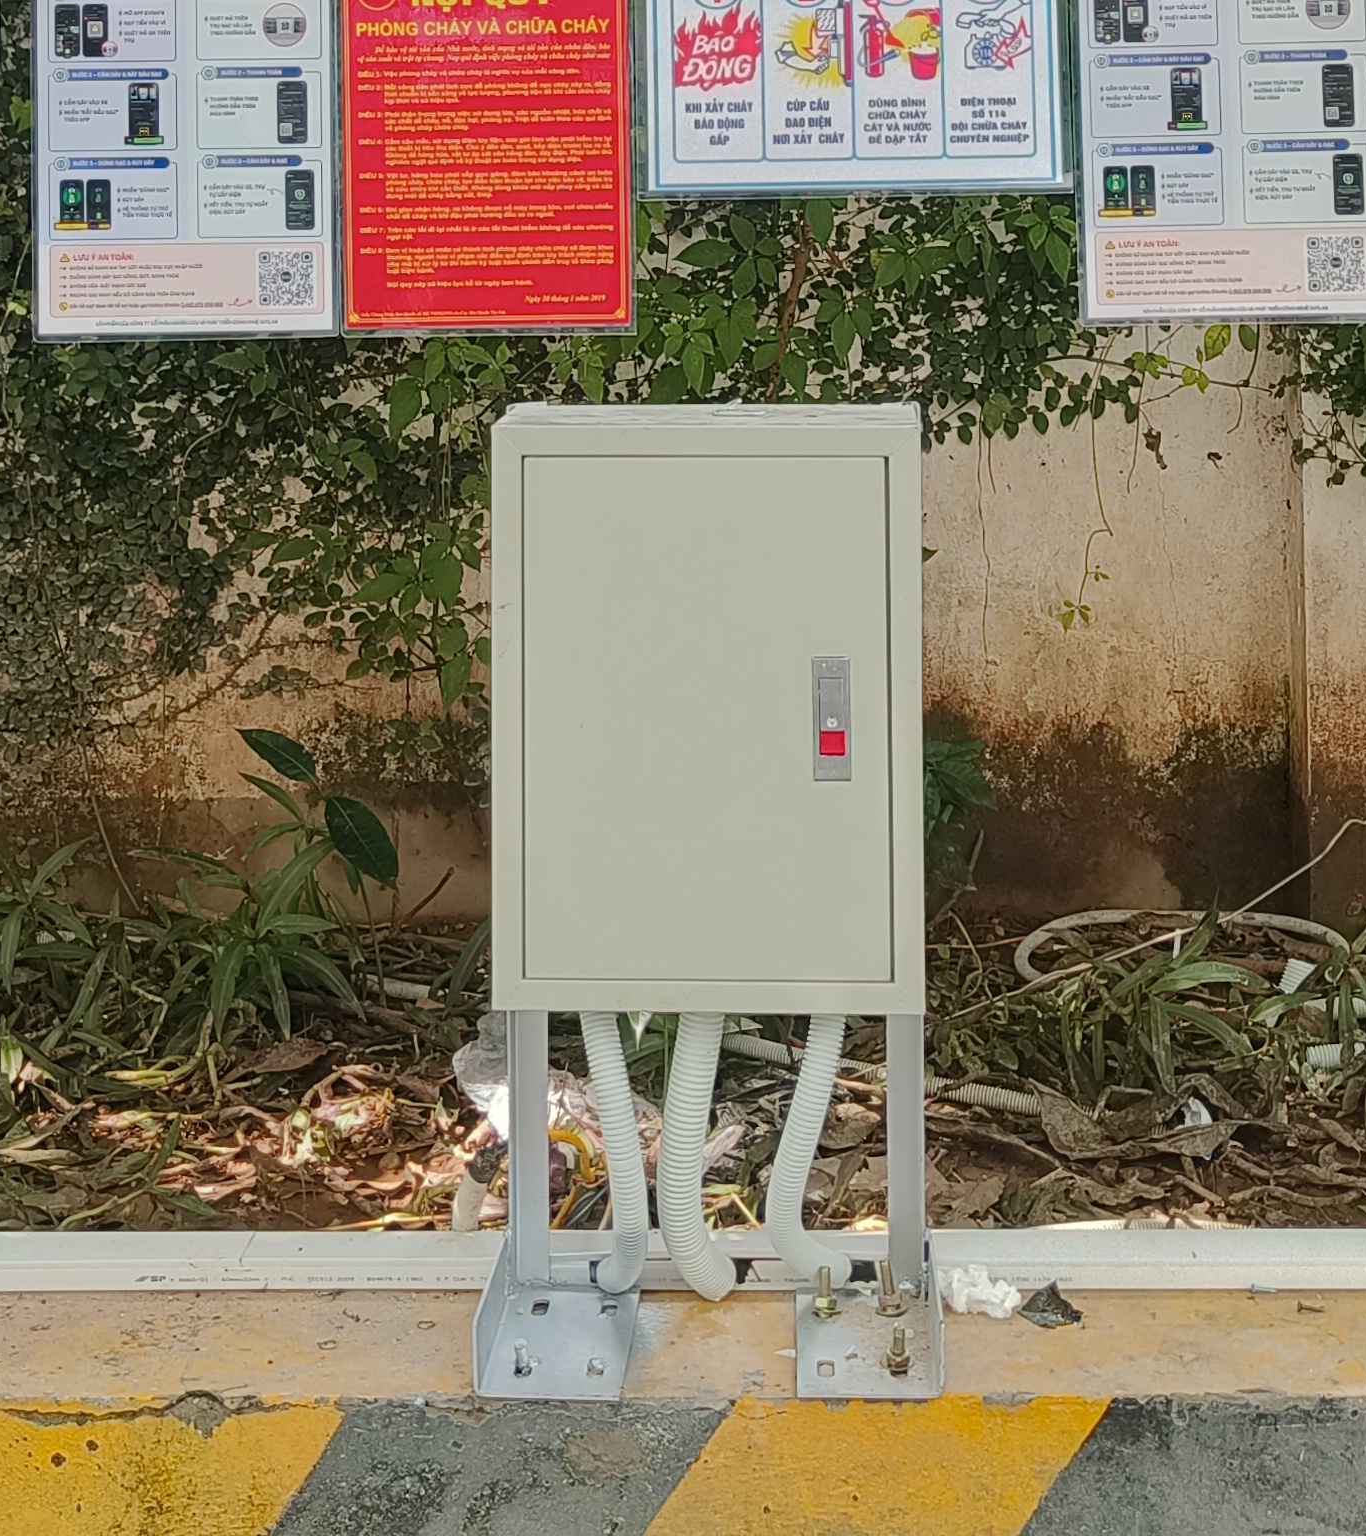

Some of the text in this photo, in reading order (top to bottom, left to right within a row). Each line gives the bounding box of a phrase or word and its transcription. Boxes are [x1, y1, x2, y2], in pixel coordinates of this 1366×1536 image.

[356, 15, 610, 37] PHÒNG CHÁY VÀ CHỮA CHÁY
[692, 32, 736, 55] BÁO
[682, 53, 753, 89] ĐỘNG
[685, 98, 753, 113] KHI XẢY CHÁY
[786, 99, 807, 112] CÚP
[868, 96, 926, 109] DÙNG BÌNH
[960, 97, 1016, 108] ĐIỆN THOẠI
[867, 109, 928, 120] CHỮA CHÁY
[971, 108, 1007, 119] SỐ 114
[694, 117, 745, 131] BÁO ĐỘNG
[785, 115, 832, 130] DAO ĐIỆN
[863, 120, 932, 132] CÁT VÀ NƯỚC
[951, 119, 1027, 132] ĐỘI CHỮA CHÁY
[709, 131, 730, 145] GẤP
[772, 129, 845, 145] NƠI XẢY CHÁY
[885, 133, 906, 146] DẬP
[909, 131, 928, 144] TẮT
[950, 132, 1030, 144] CHUYÊN NGHIỆP
[1143, 240, 1155, 248] AN
